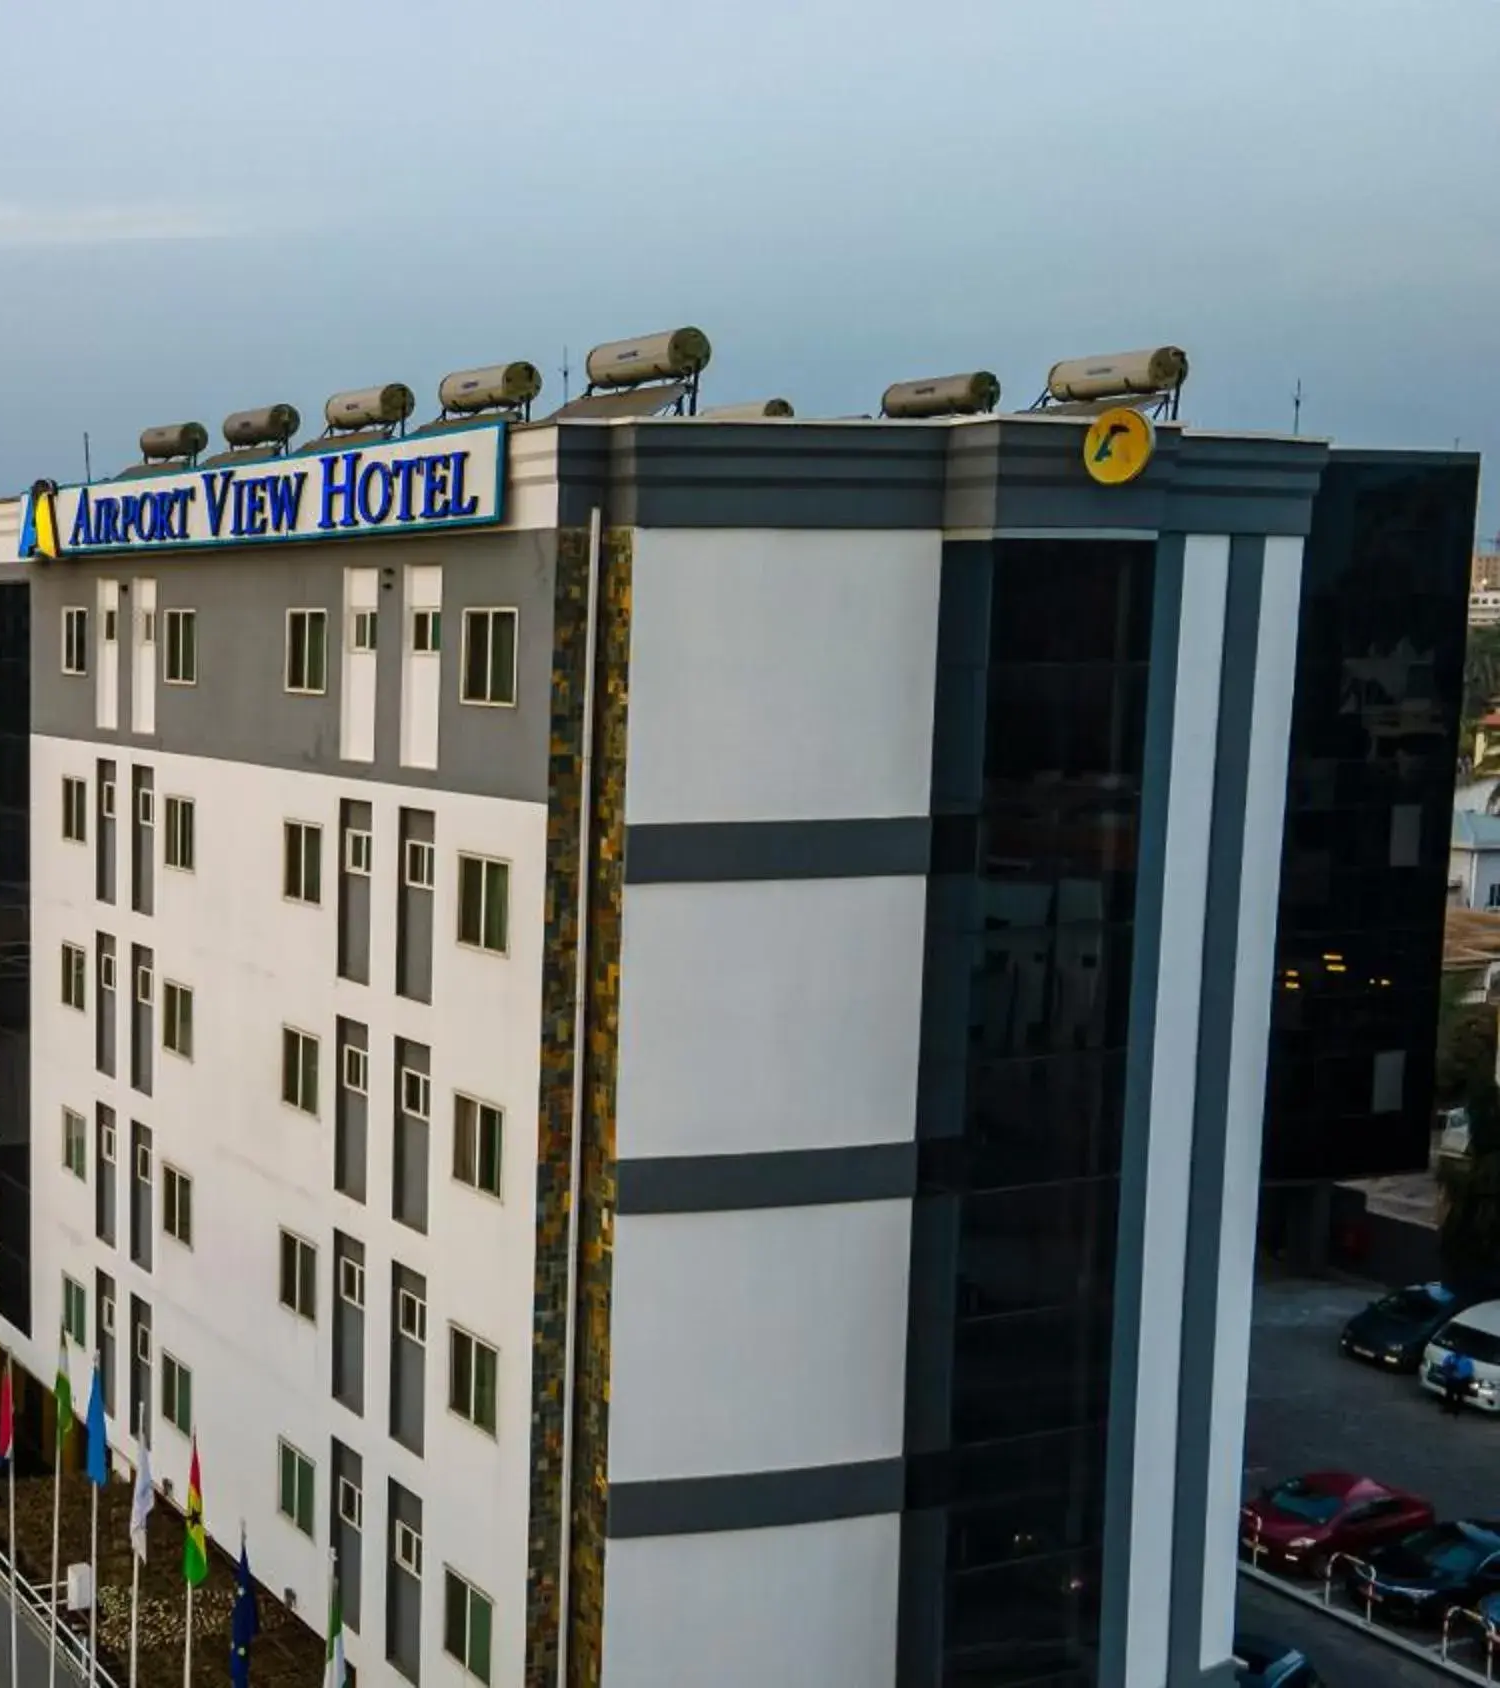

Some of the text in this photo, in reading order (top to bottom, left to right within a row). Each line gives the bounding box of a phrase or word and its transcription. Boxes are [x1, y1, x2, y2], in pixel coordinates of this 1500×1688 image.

[69, 451, 479, 546] AIRPORT VIEW HOTEL
